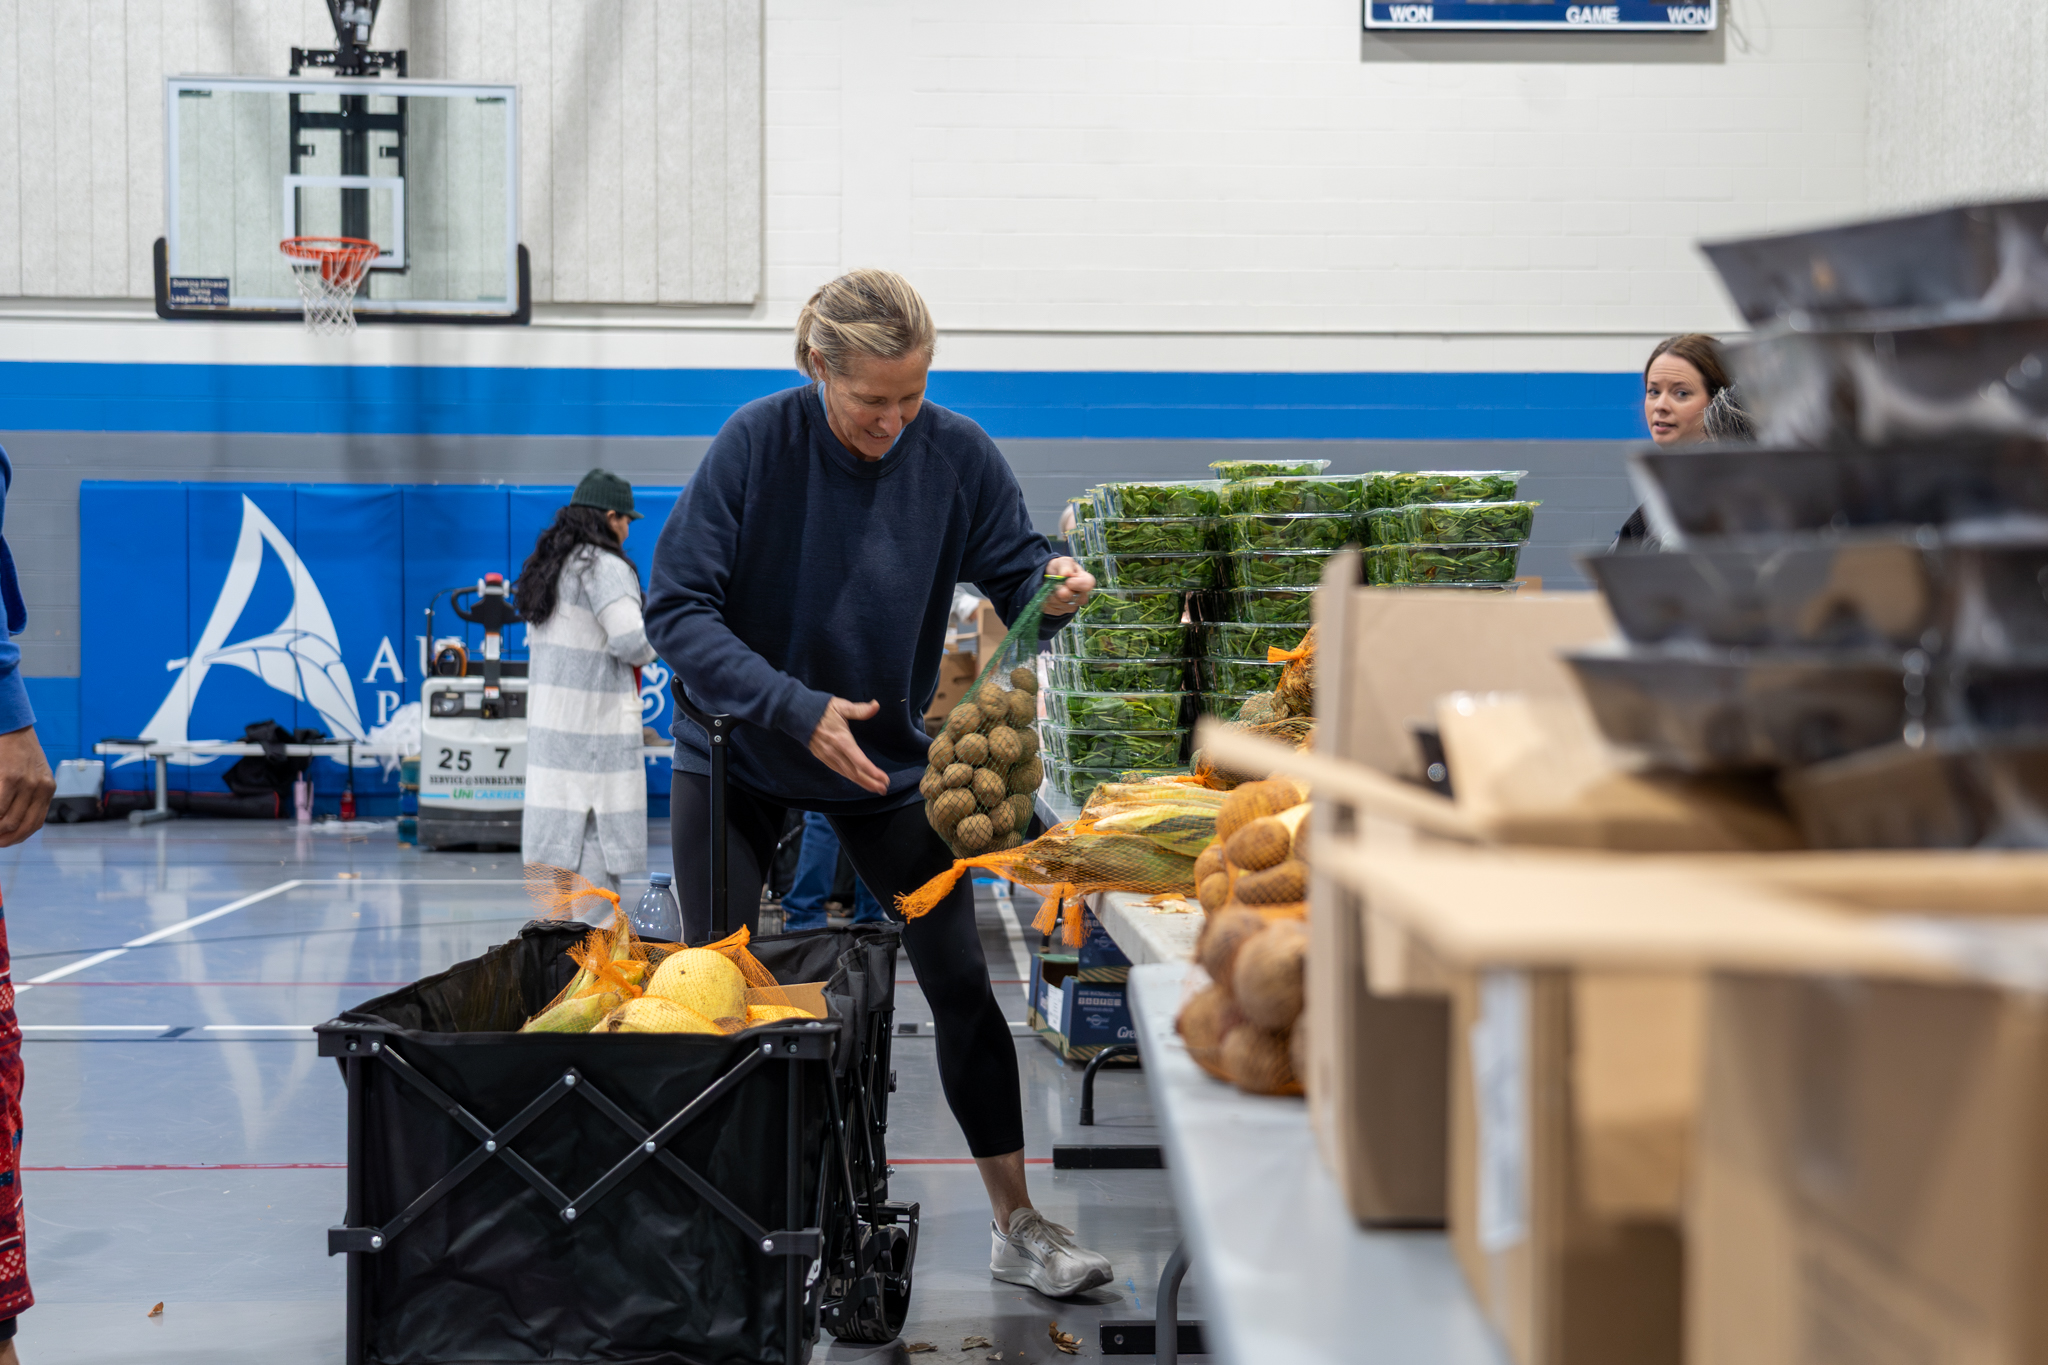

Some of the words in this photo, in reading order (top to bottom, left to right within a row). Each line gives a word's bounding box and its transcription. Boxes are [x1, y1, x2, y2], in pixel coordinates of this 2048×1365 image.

[1389, 5, 1433, 23] WON
[1565, 5, 1619, 24] GAME
[1667, 5, 1709, 23] WON
[438, 747, 472, 773] 25
[495, 747, 512, 769] 7
